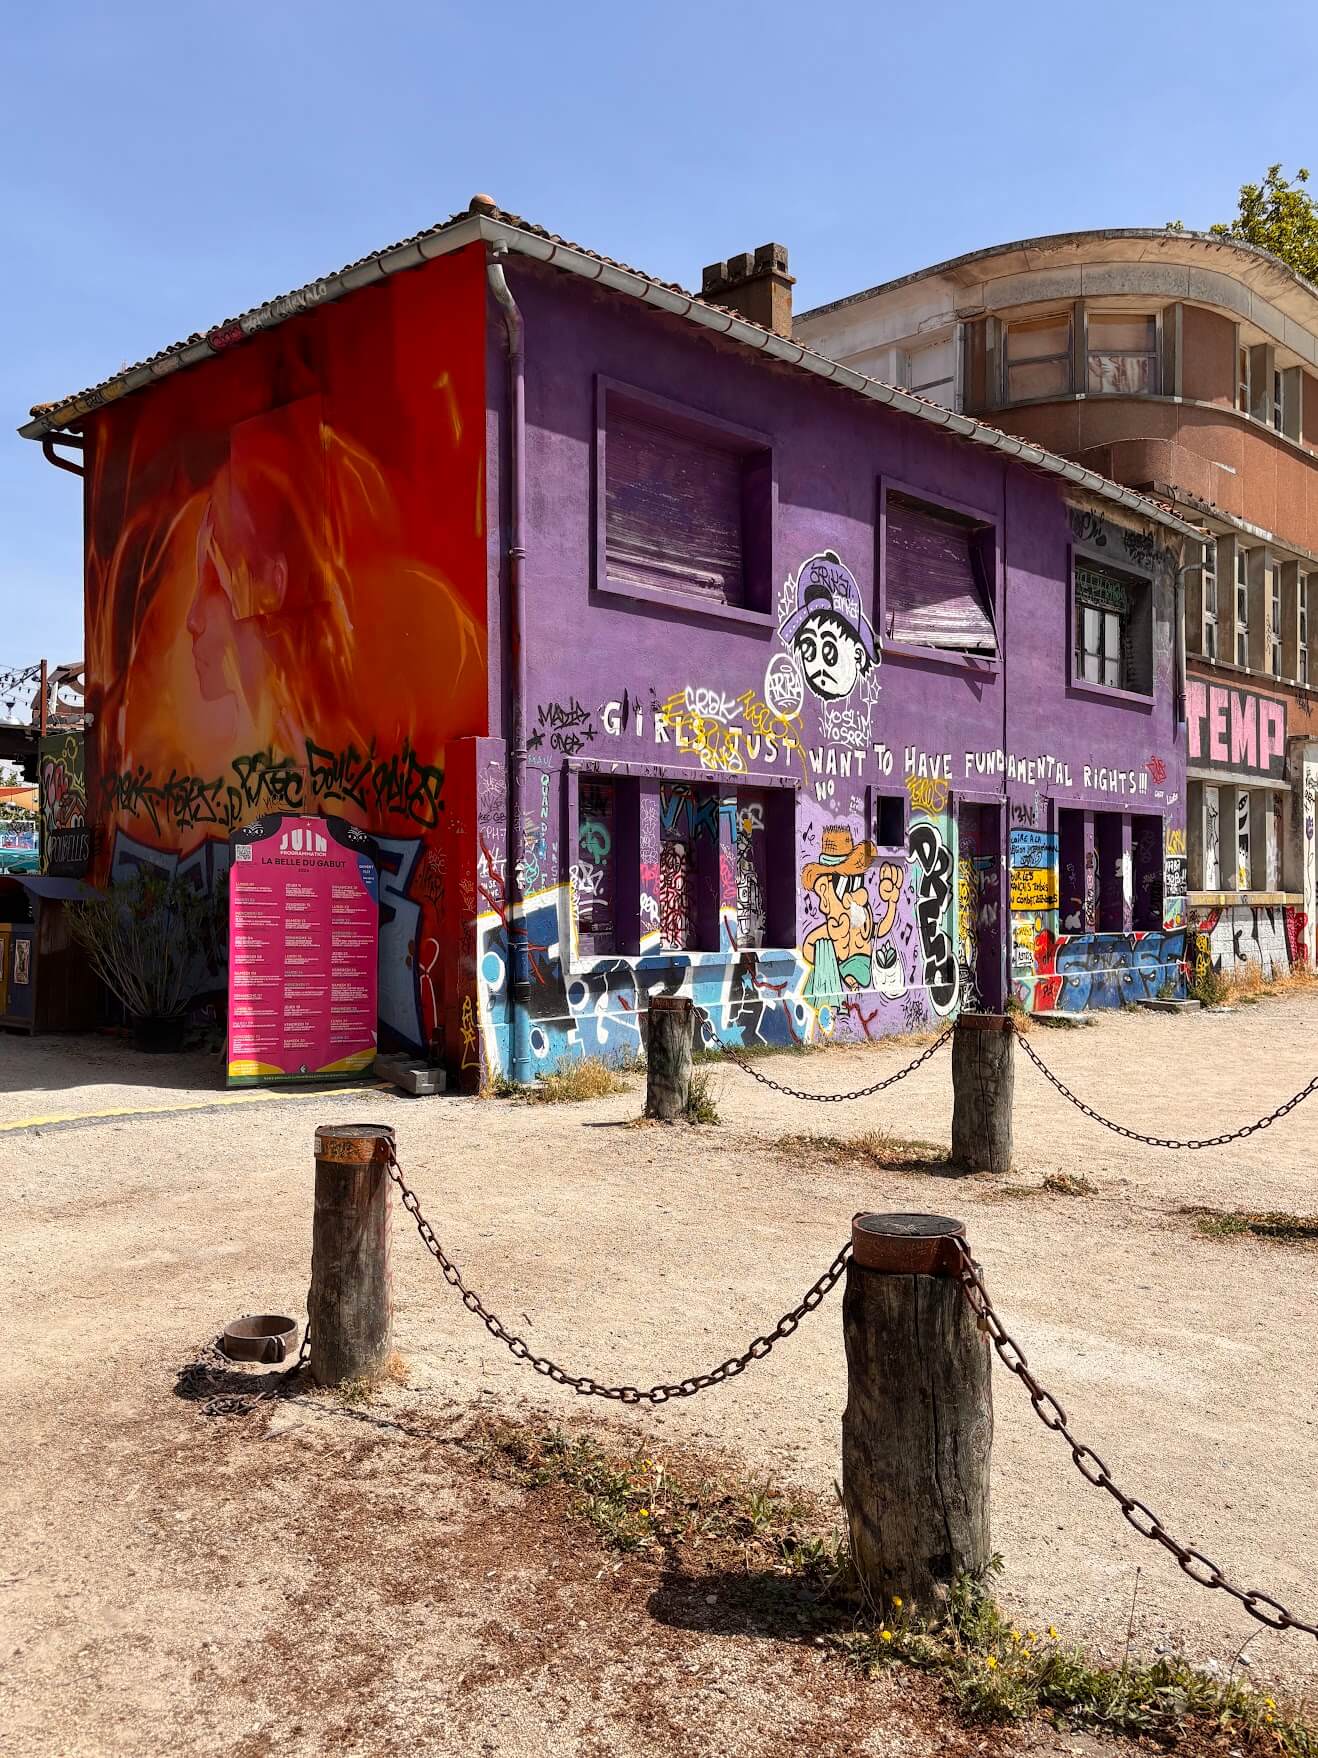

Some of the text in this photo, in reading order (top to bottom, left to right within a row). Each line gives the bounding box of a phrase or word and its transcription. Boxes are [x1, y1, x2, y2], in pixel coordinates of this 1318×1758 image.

[1184, 680, 1285, 770] TEMP
[728, 726, 796, 767] JUST
[809, 746, 866, 778] WANT
[873, 743, 894, 776] TO
[904, 746, 953, 780] HAVE
[965, 748, 1073, 787] FUNDAMENTAL
[48, 834, 89, 863] POUBELLES
[279, 828, 327, 852] JUIN
[261, 857, 347, 869] LA BELLE DU GABUT
